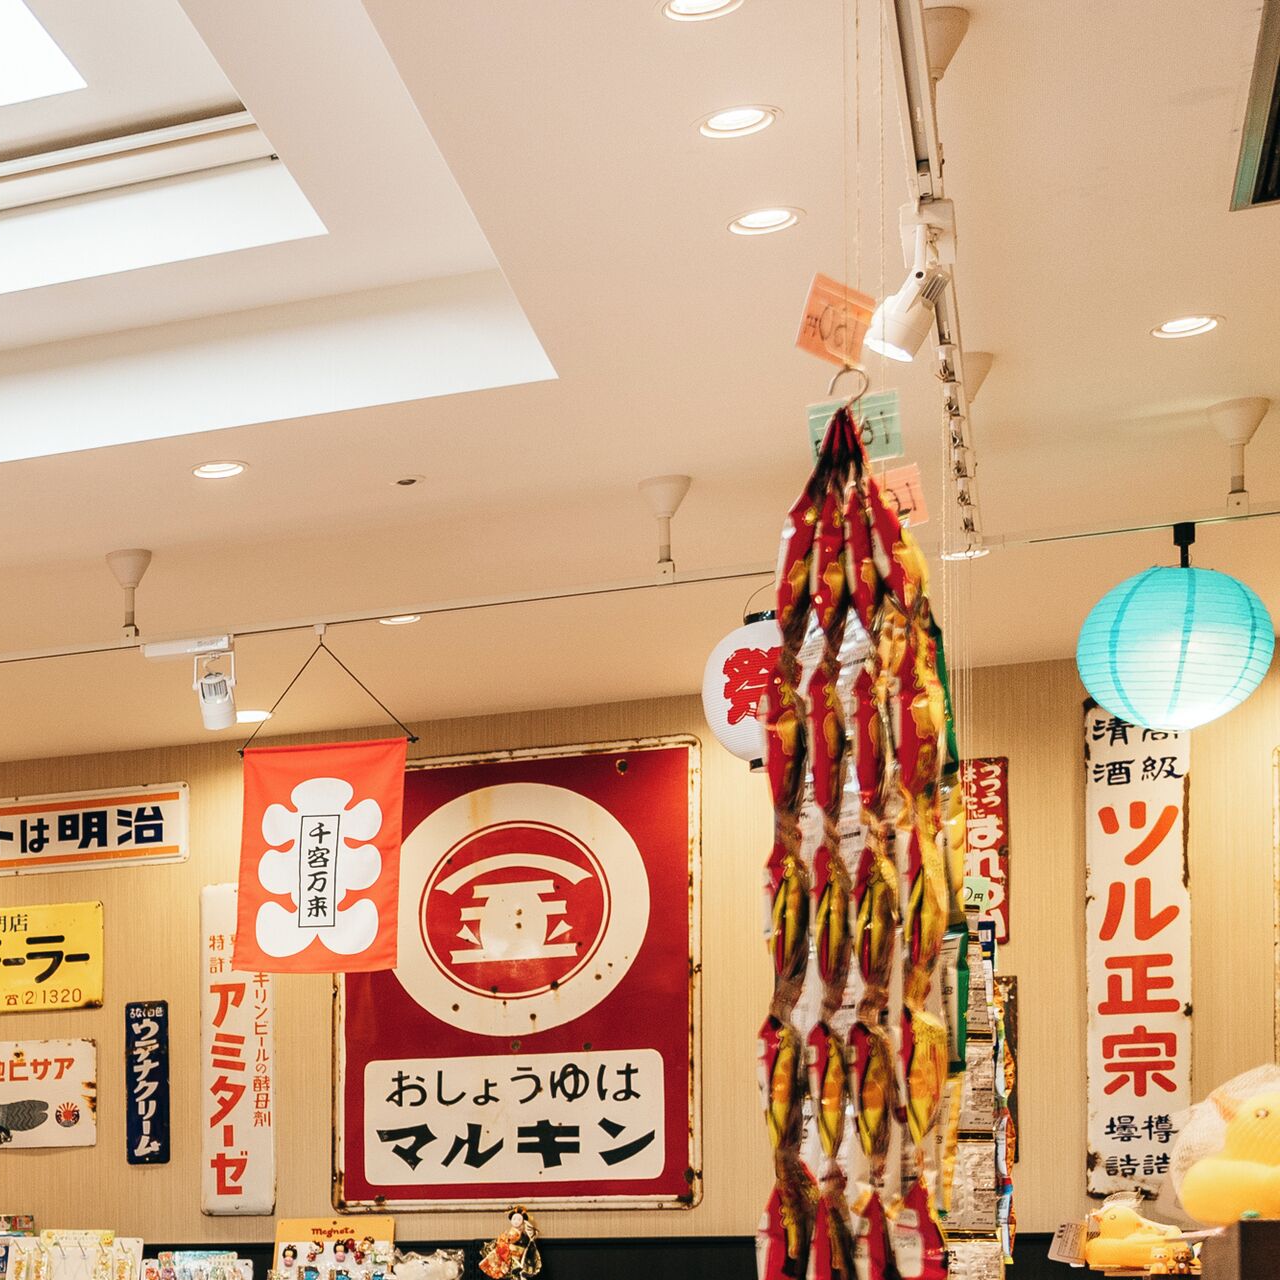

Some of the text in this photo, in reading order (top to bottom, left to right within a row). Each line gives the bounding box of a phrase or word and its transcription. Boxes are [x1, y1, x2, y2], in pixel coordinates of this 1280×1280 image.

[1091, 716, 1136, 787] 清酒
[305, 821, 334, 921] 千客万来
[208, 933, 226, 976] 特許
[1096, 800, 1182, 1100] ツル正宗
[130, 1019, 162, 1158] ウテナクリーム
[208, 981, 249, 1196] アミターゼ
[384, 1061, 643, 1107] おしょうゆは
[374, 1115, 657, 1170] マルキン
[311, 1227, 356, 1238] Magnets
